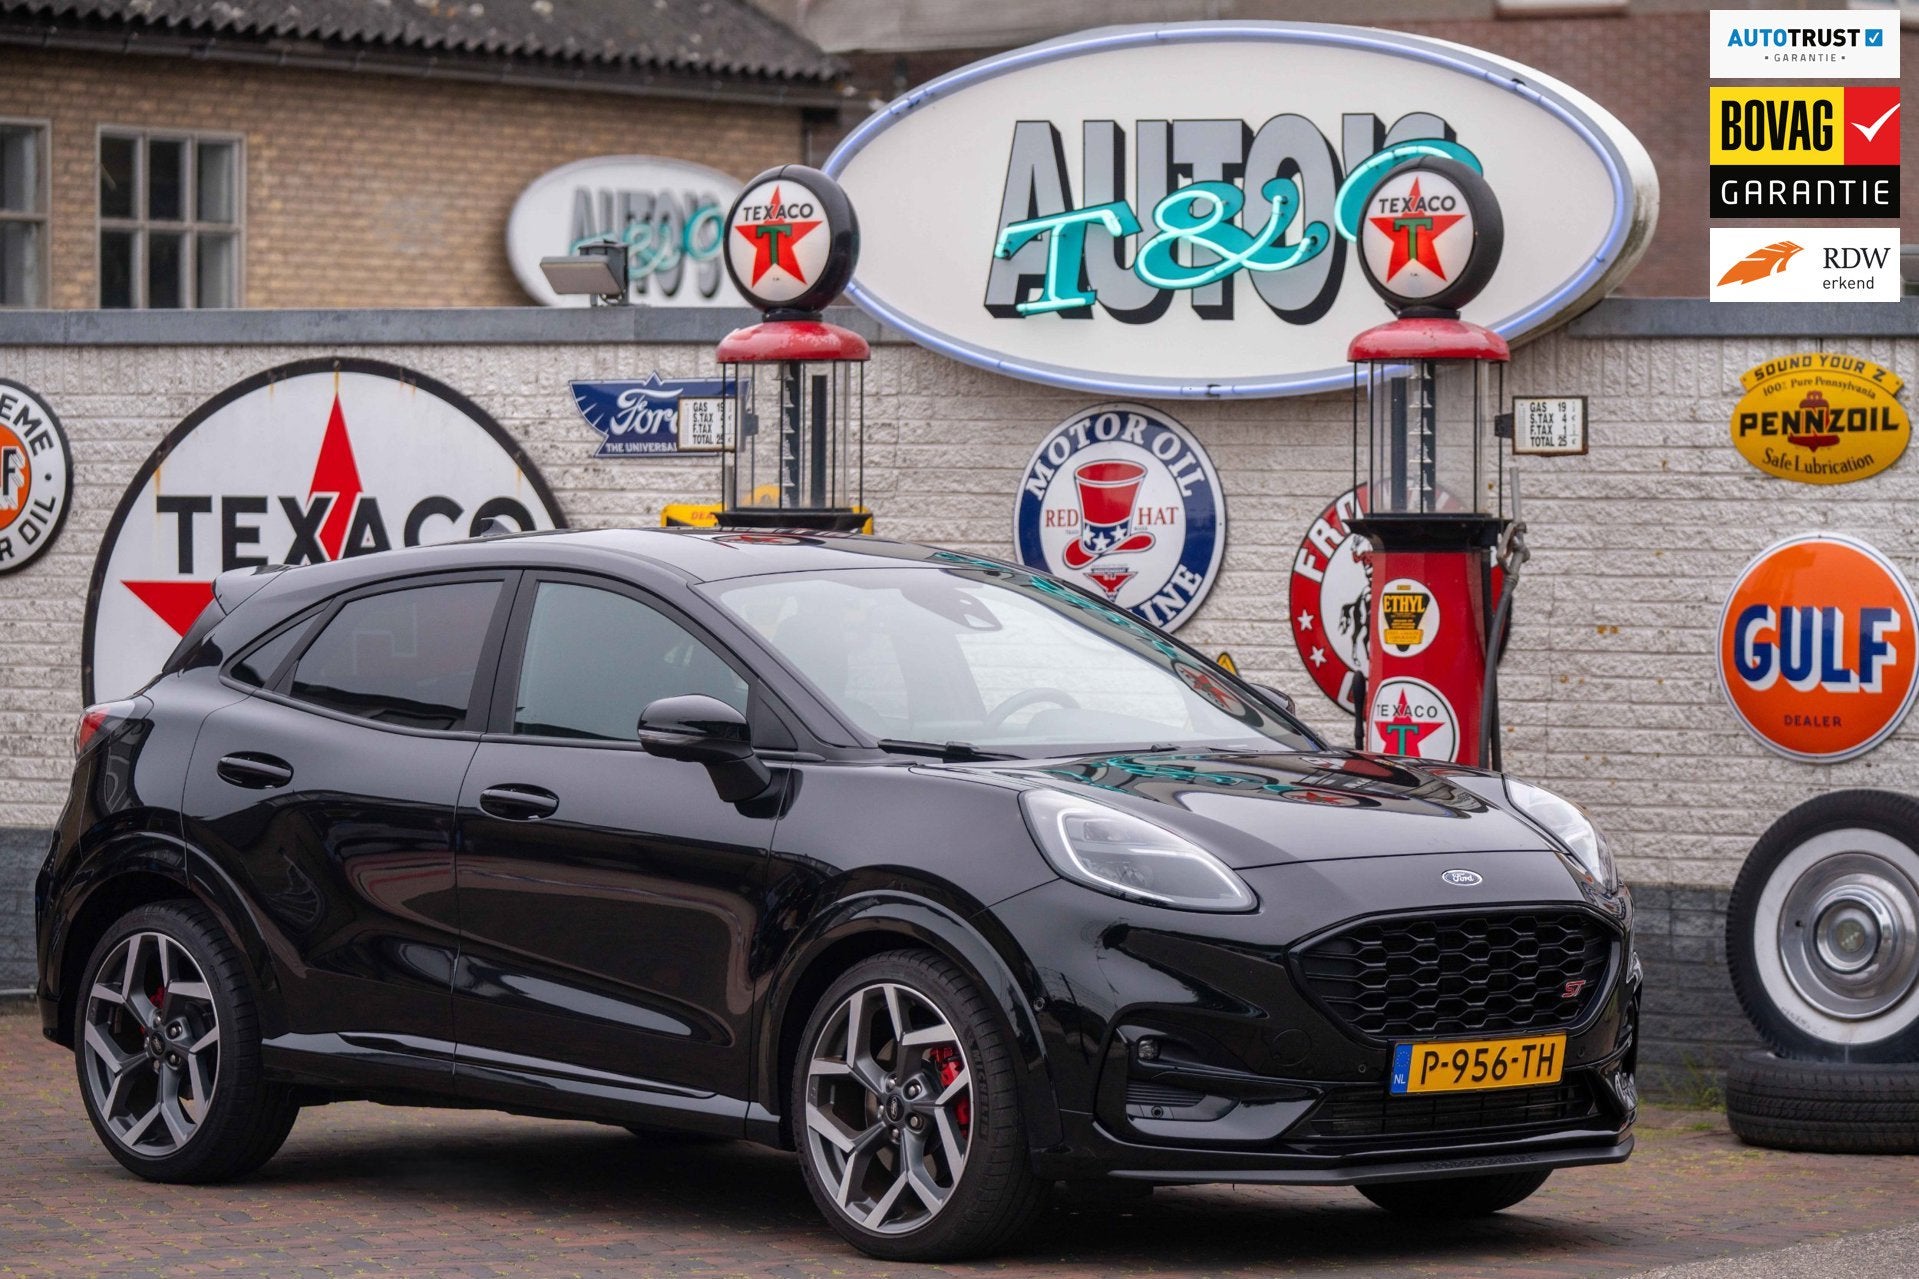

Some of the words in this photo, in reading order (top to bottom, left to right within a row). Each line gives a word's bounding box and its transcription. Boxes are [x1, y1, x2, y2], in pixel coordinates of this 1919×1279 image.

[743, 203, 814, 222] TEXACO
[1379, 195, 1456, 214] TEXACO
[1754, 355, 1812, 381] SOUND
[1819, 355, 1866, 374] YOUR
[1872, 368, 1887, 382] Z
[1791, 378, 1813, 388] Pure
[1815, 376, 1876, 400] Pennsylvania
[693, 401, 708, 412] GAS
[1530, 402, 1547, 412] GAS
[1558, 402, 1567, 412] 19
[1562, 413, 1567, 423] 4
[1739, 406, 1900, 438] PENNZOIL
[606, 442, 624, 452] THE
[693, 434, 714, 445] TOTAL
[1530, 436, 1555, 447] TOTAL
[1558, 435, 1568, 447] 25
[1024, 412, 1149, 501] MOTOR
[1152, 431, 1206, 498] OIL
[1762, 447, 1792, 471] Safe
[1794, 453, 1875, 475] Lubrication
[18, 497, 56, 545] OIL
[1045, 509, 1079, 528] RED
[1138, 506, 1179, 526] HAT
[1383, 595, 1425, 613] ETHYL
[1734, 604, 1901, 693] GULF
[1376, 704, 1438, 719] TEXACO
[1784, 715, 1842, 728] DEALER
[1394, 1073, 1406, 1085] NL
[1420, 1042, 1556, 1085] P-956-TH
